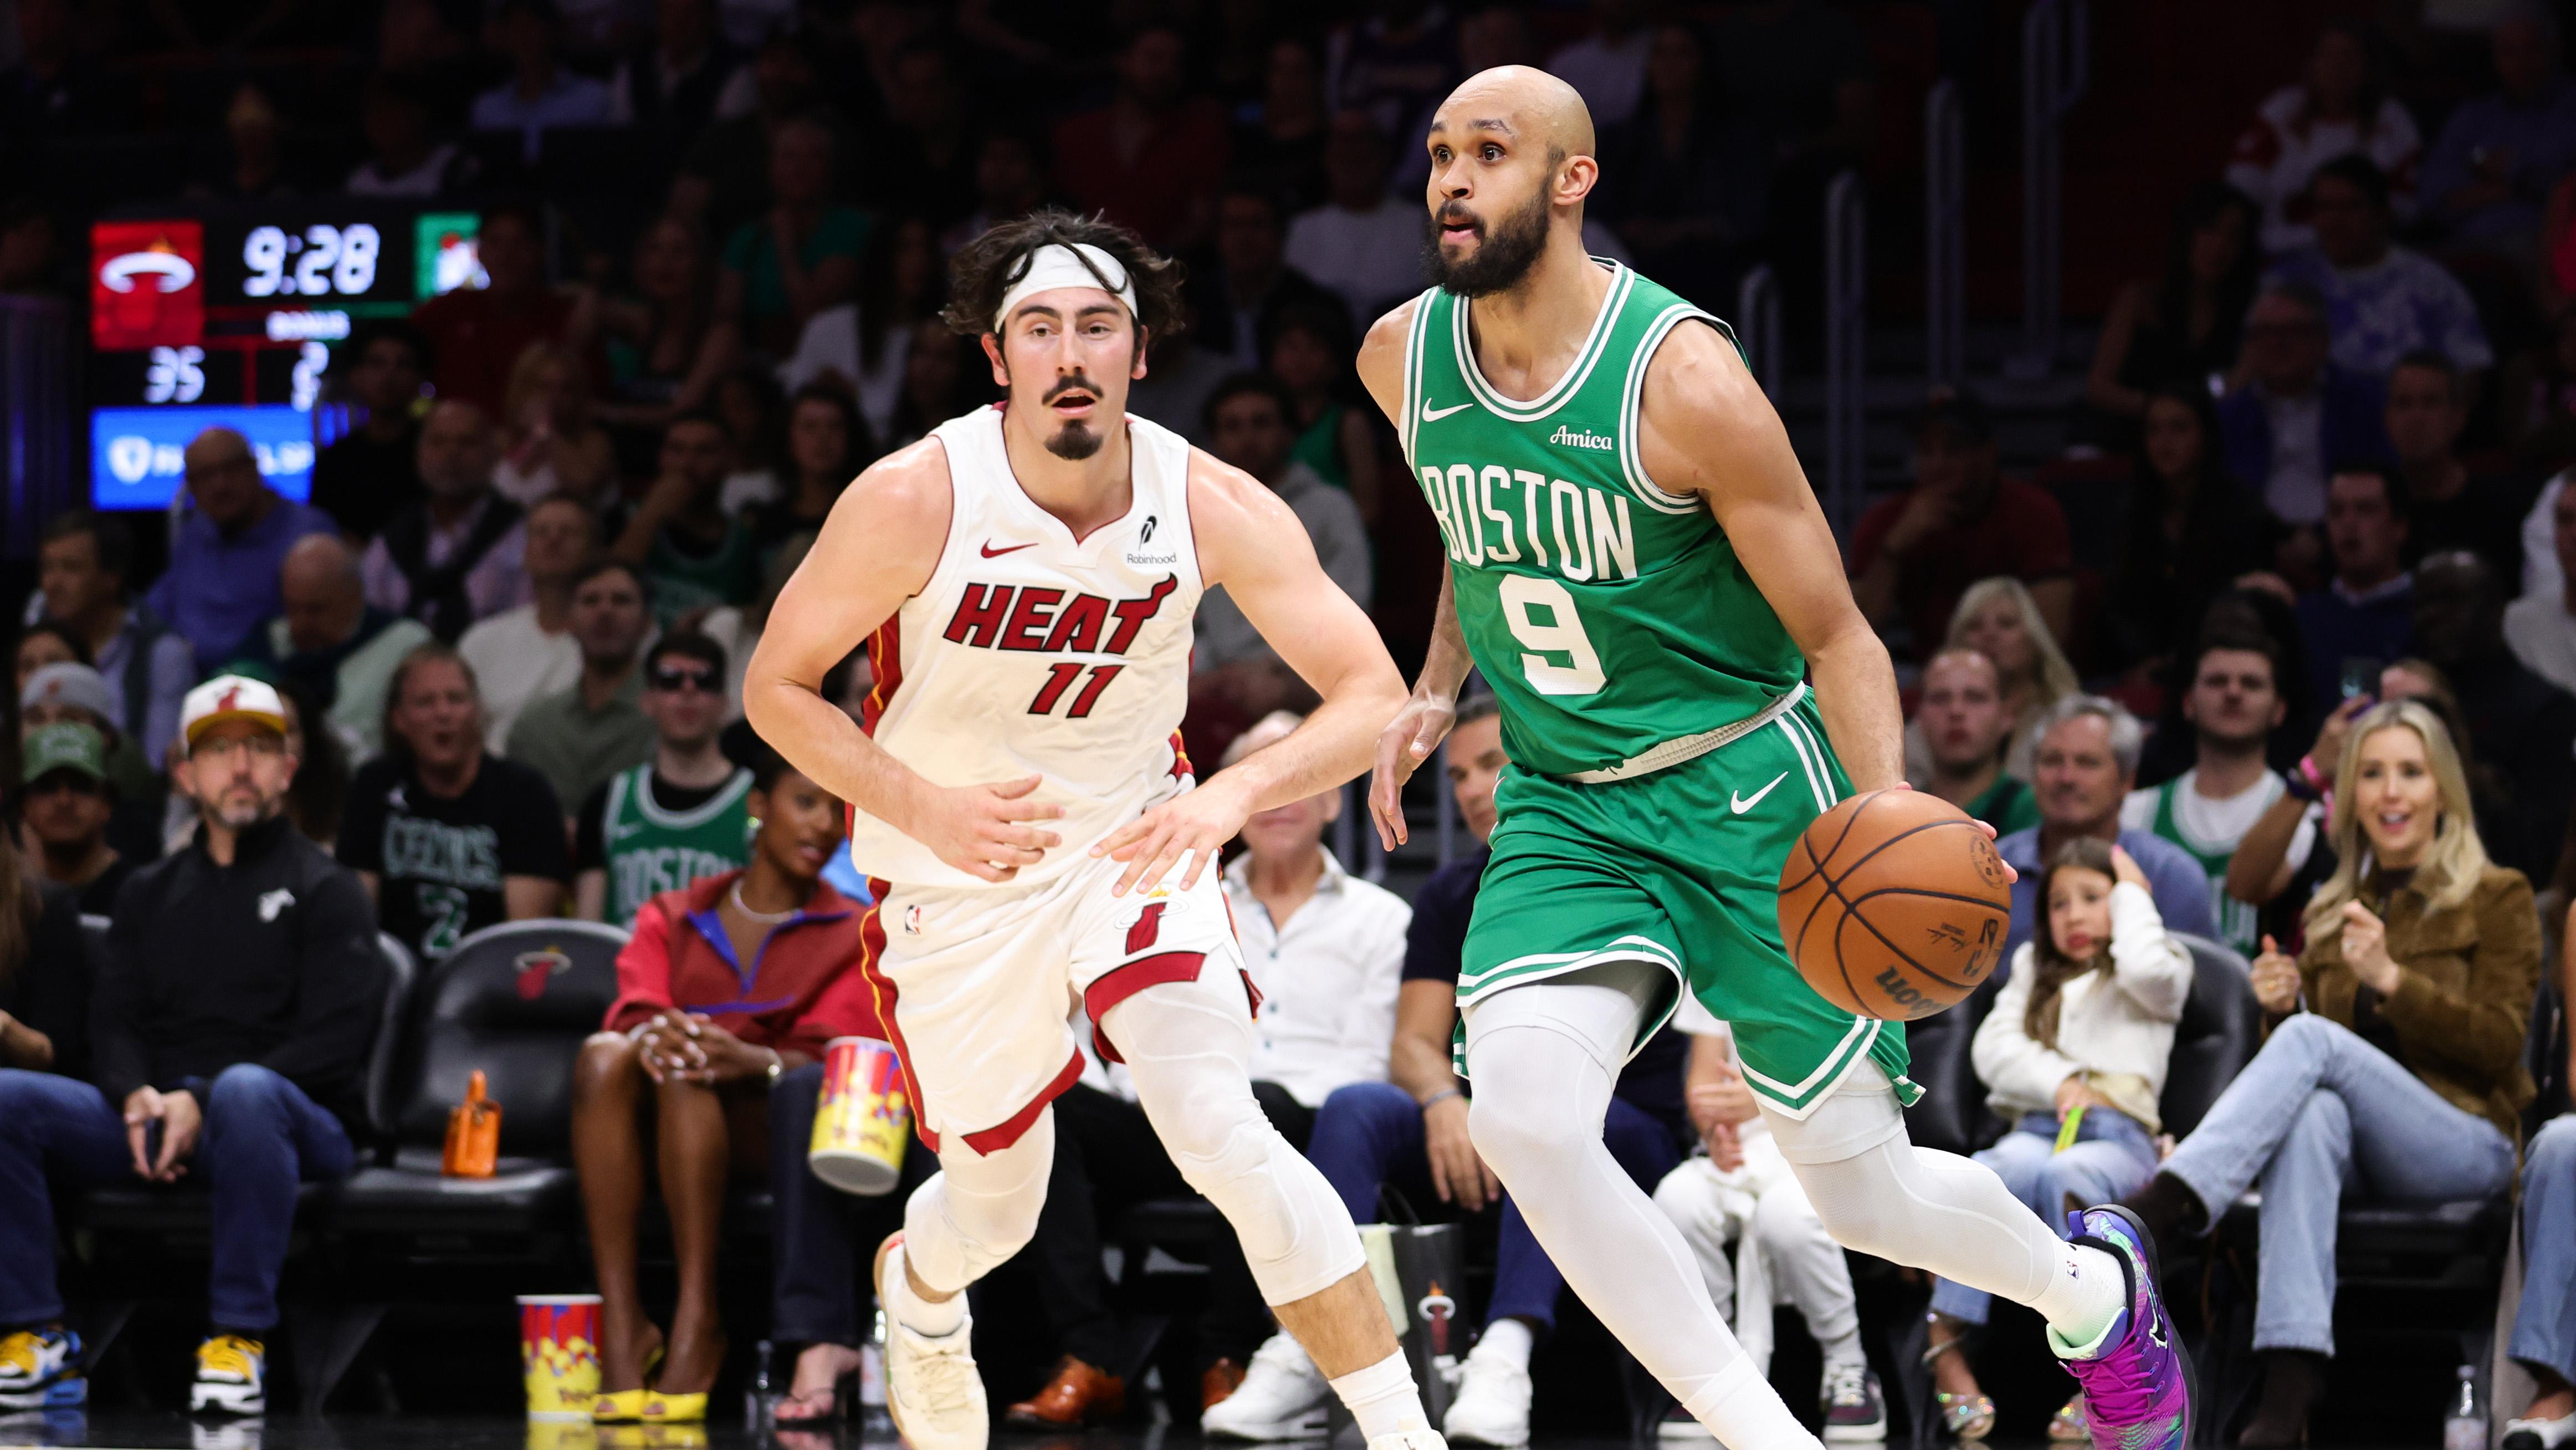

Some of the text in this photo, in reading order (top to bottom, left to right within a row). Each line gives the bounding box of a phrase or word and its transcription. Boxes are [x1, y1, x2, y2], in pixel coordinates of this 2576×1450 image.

[243, 223, 381, 297] 9:28
[144, 345, 206, 403] 35
[1550, 425, 1613, 451] Amica
[1420, 463, 1638, 582] BOSTON
[1127, 552, 1177, 564] Robinhood
[942, 571, 1178, 655] HEAT
[1498, 573, 1607, 696] 9
[1027, 662, 1128, 718] 11
[613, 846, 733, 916] BOST
